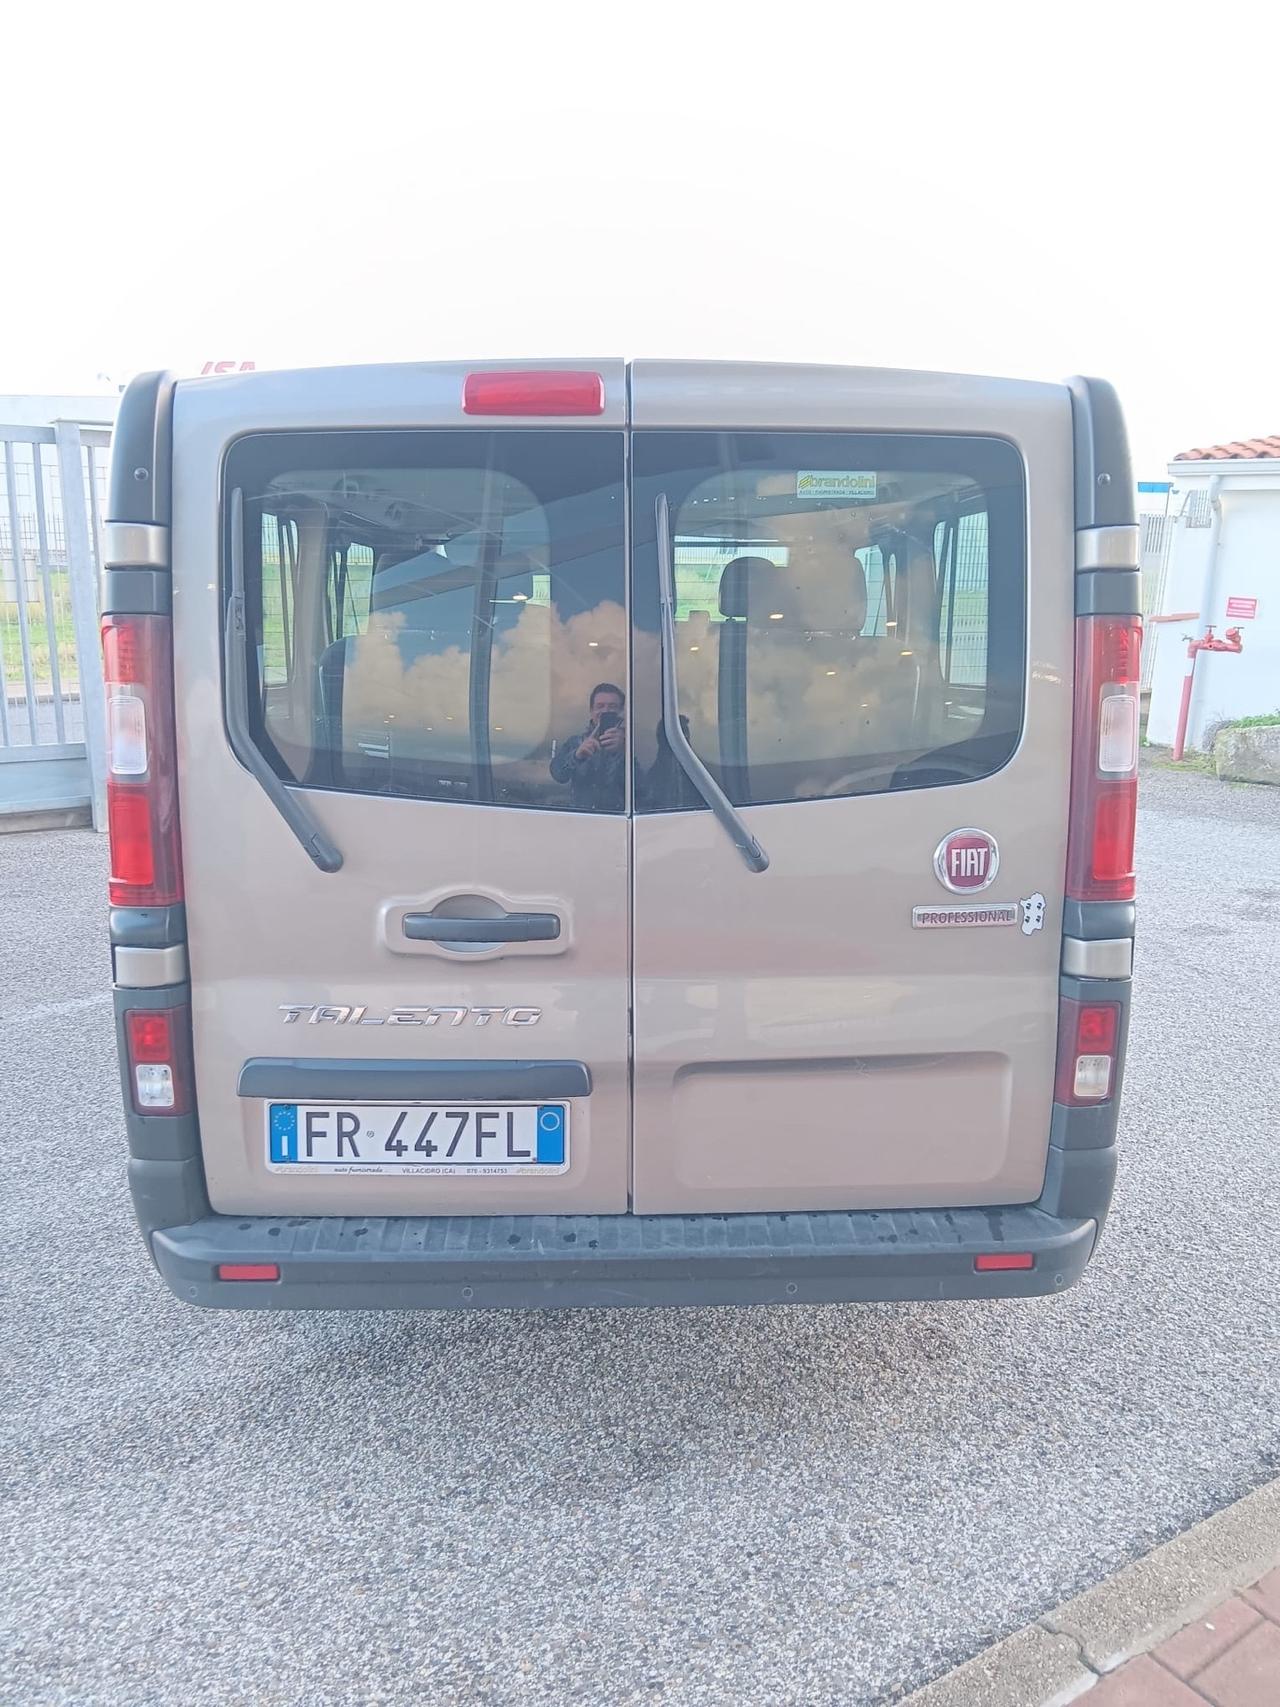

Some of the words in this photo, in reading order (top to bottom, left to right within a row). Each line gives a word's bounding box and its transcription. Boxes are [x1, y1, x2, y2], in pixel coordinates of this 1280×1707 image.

[811, 474, 875, 488] brandolini
[951, 847, 988, 877] FIAT
[921, 909, 1012, 924] PROFESSIONAL
[277, 1004, 543, 1027] TALENTO
[305, 1111, 361, 1157] FR
[384, 1111, 532, 1157] 447FL
